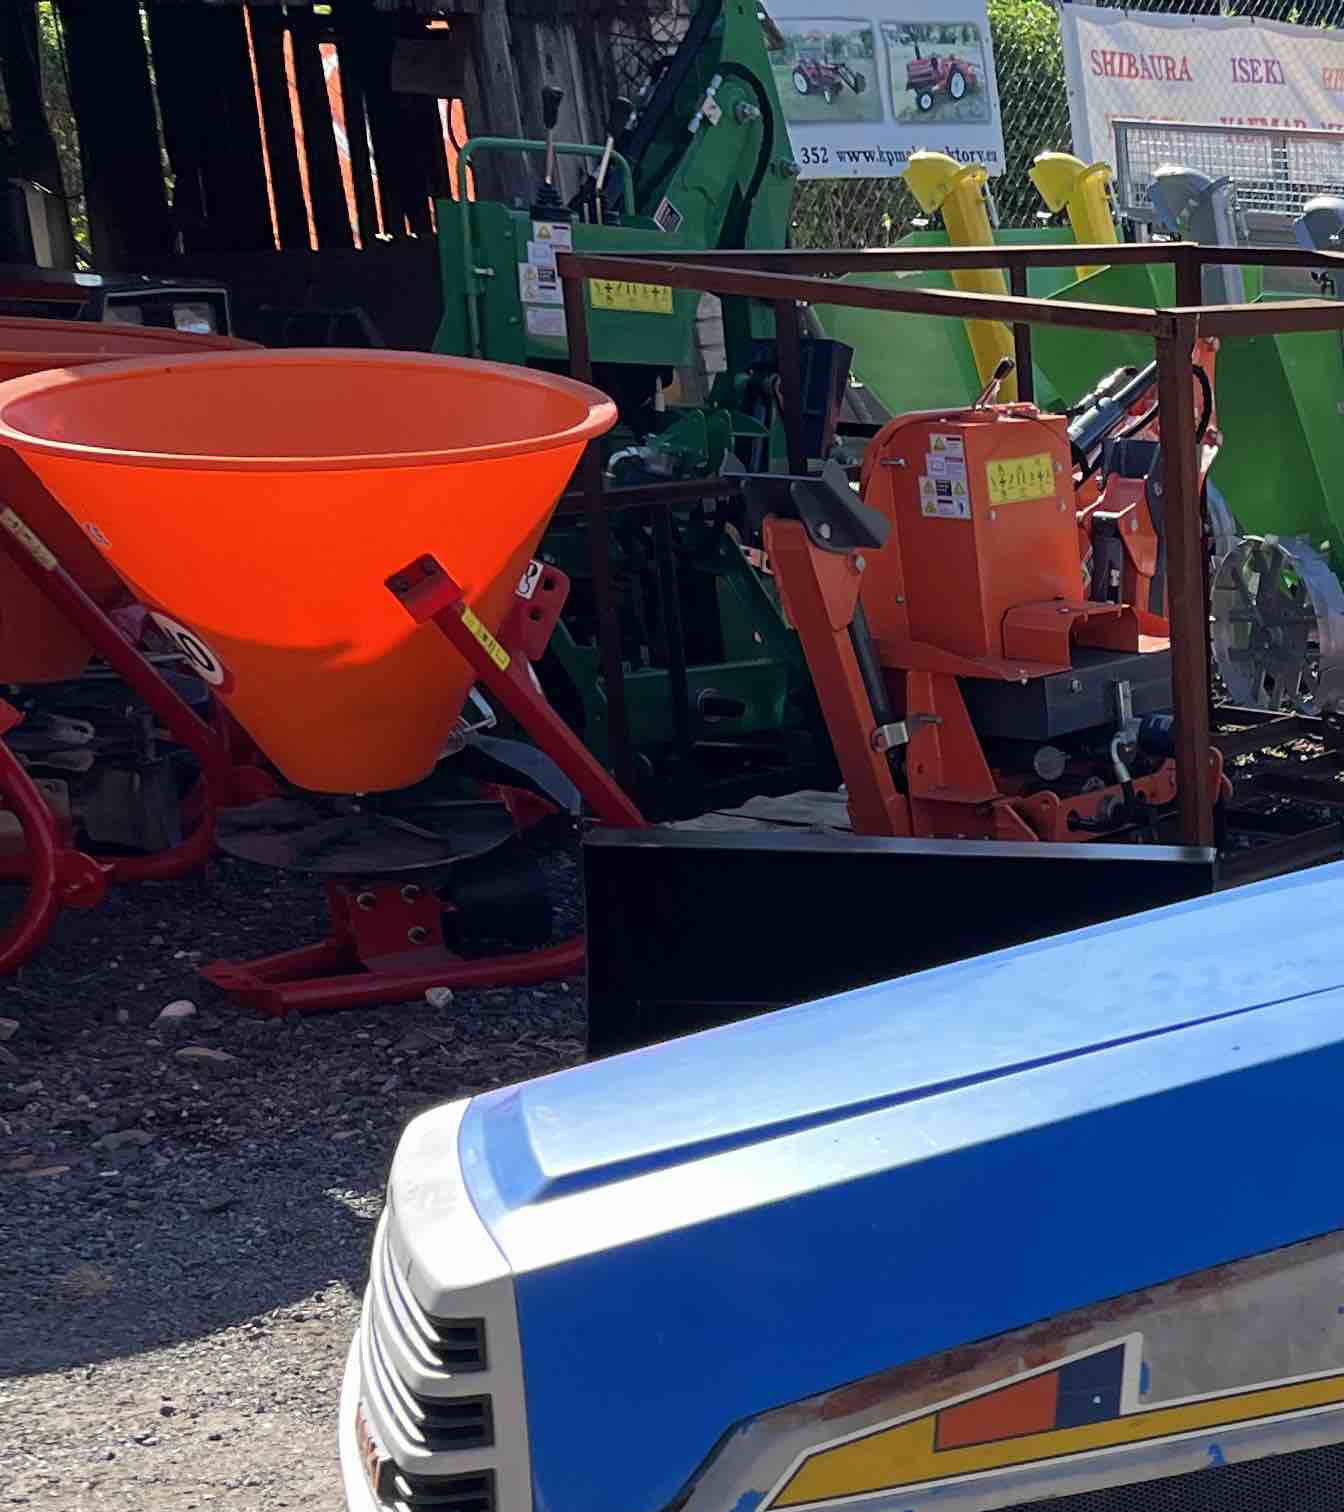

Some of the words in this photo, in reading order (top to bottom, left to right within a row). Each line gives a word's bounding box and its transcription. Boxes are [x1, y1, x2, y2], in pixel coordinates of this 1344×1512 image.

[1090, 48, 1193, 82] SHIBAURA
[1231, 57, 1286, 85] ISEKI
[801, 147, 829, 164] 352
